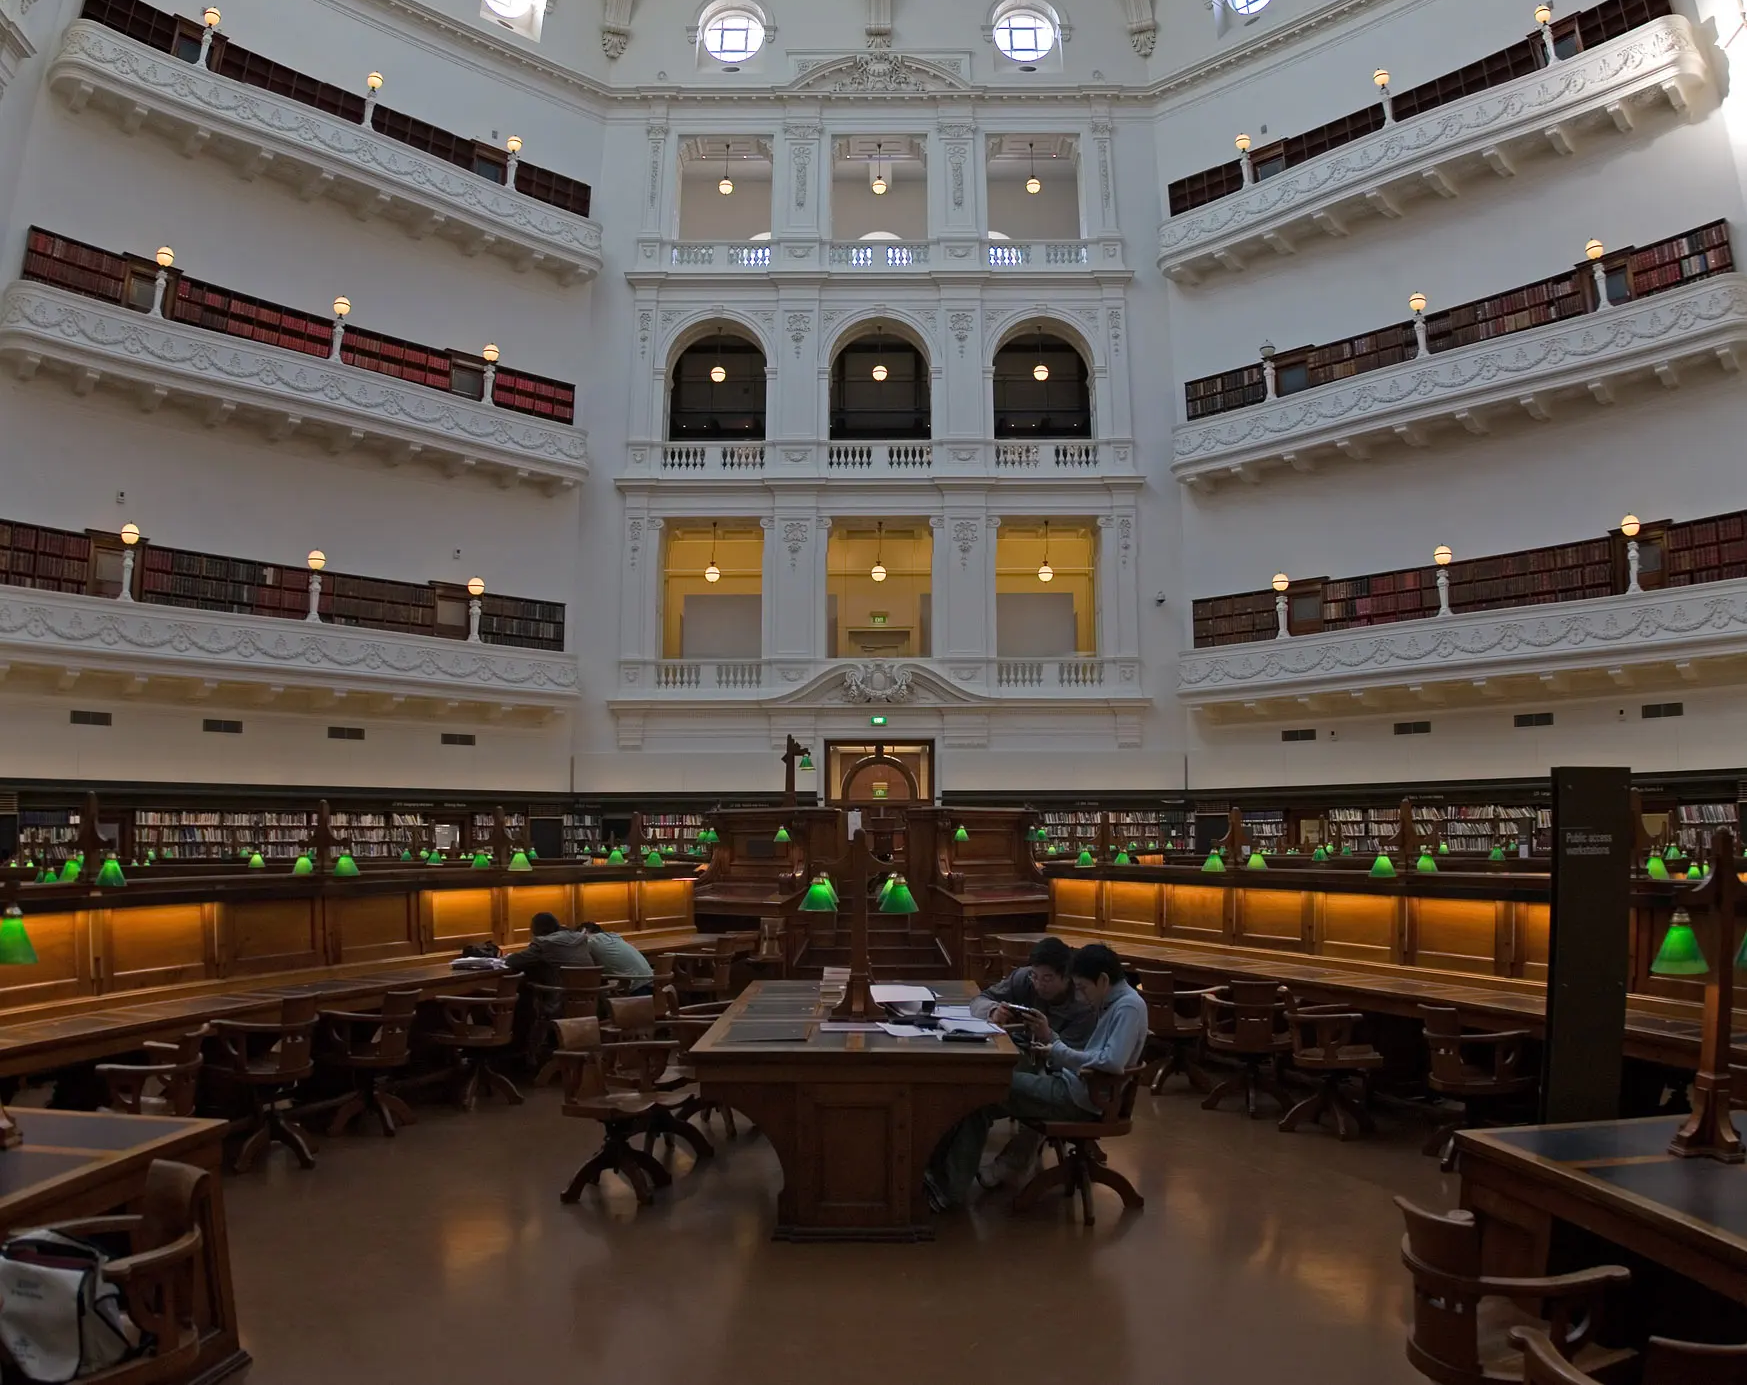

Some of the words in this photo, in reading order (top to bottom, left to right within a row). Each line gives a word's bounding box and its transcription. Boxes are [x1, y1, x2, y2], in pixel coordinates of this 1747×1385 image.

[1565, 831, 1587, 843] Public
[1588, 833, 1613, 843] access
[1565, 844, 1610, 855] workstations
